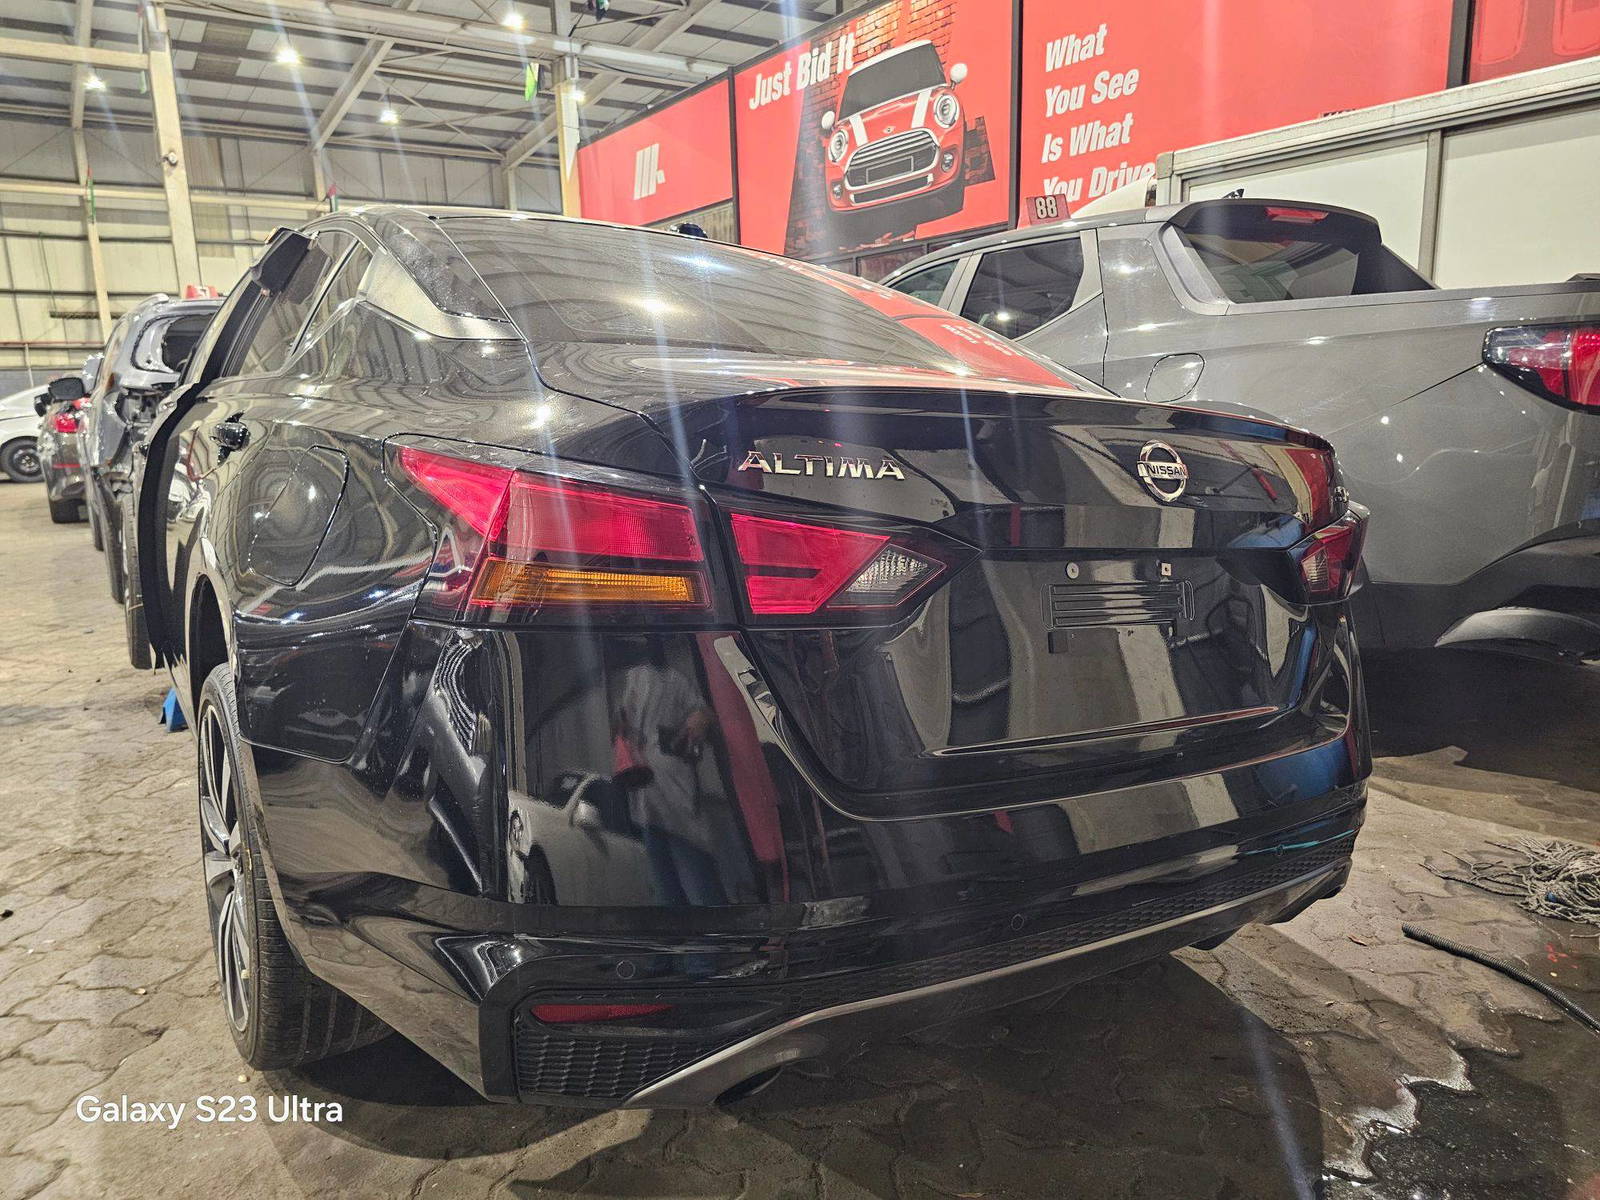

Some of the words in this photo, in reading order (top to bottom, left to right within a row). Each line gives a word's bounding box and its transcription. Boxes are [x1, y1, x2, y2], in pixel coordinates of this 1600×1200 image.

[748, 61, 793, 110] Just
[796, 41, 833, 91] Bid
[836, 32, 856, 75] It
[1045, 23, 1108, 72] What
[1045, 84, 1086, 118] You
[1091, 68, 1140, 104] See
[1041, 133, 1063, 164] Is
[1069, 112, 1134, 157] What
[1043, 176, 1083, 203] You
[1088, 161, 1157, 199] Drive
[1034, 195, 1059, 219] 88
[737, 450, 906, 481] ALTIMA
